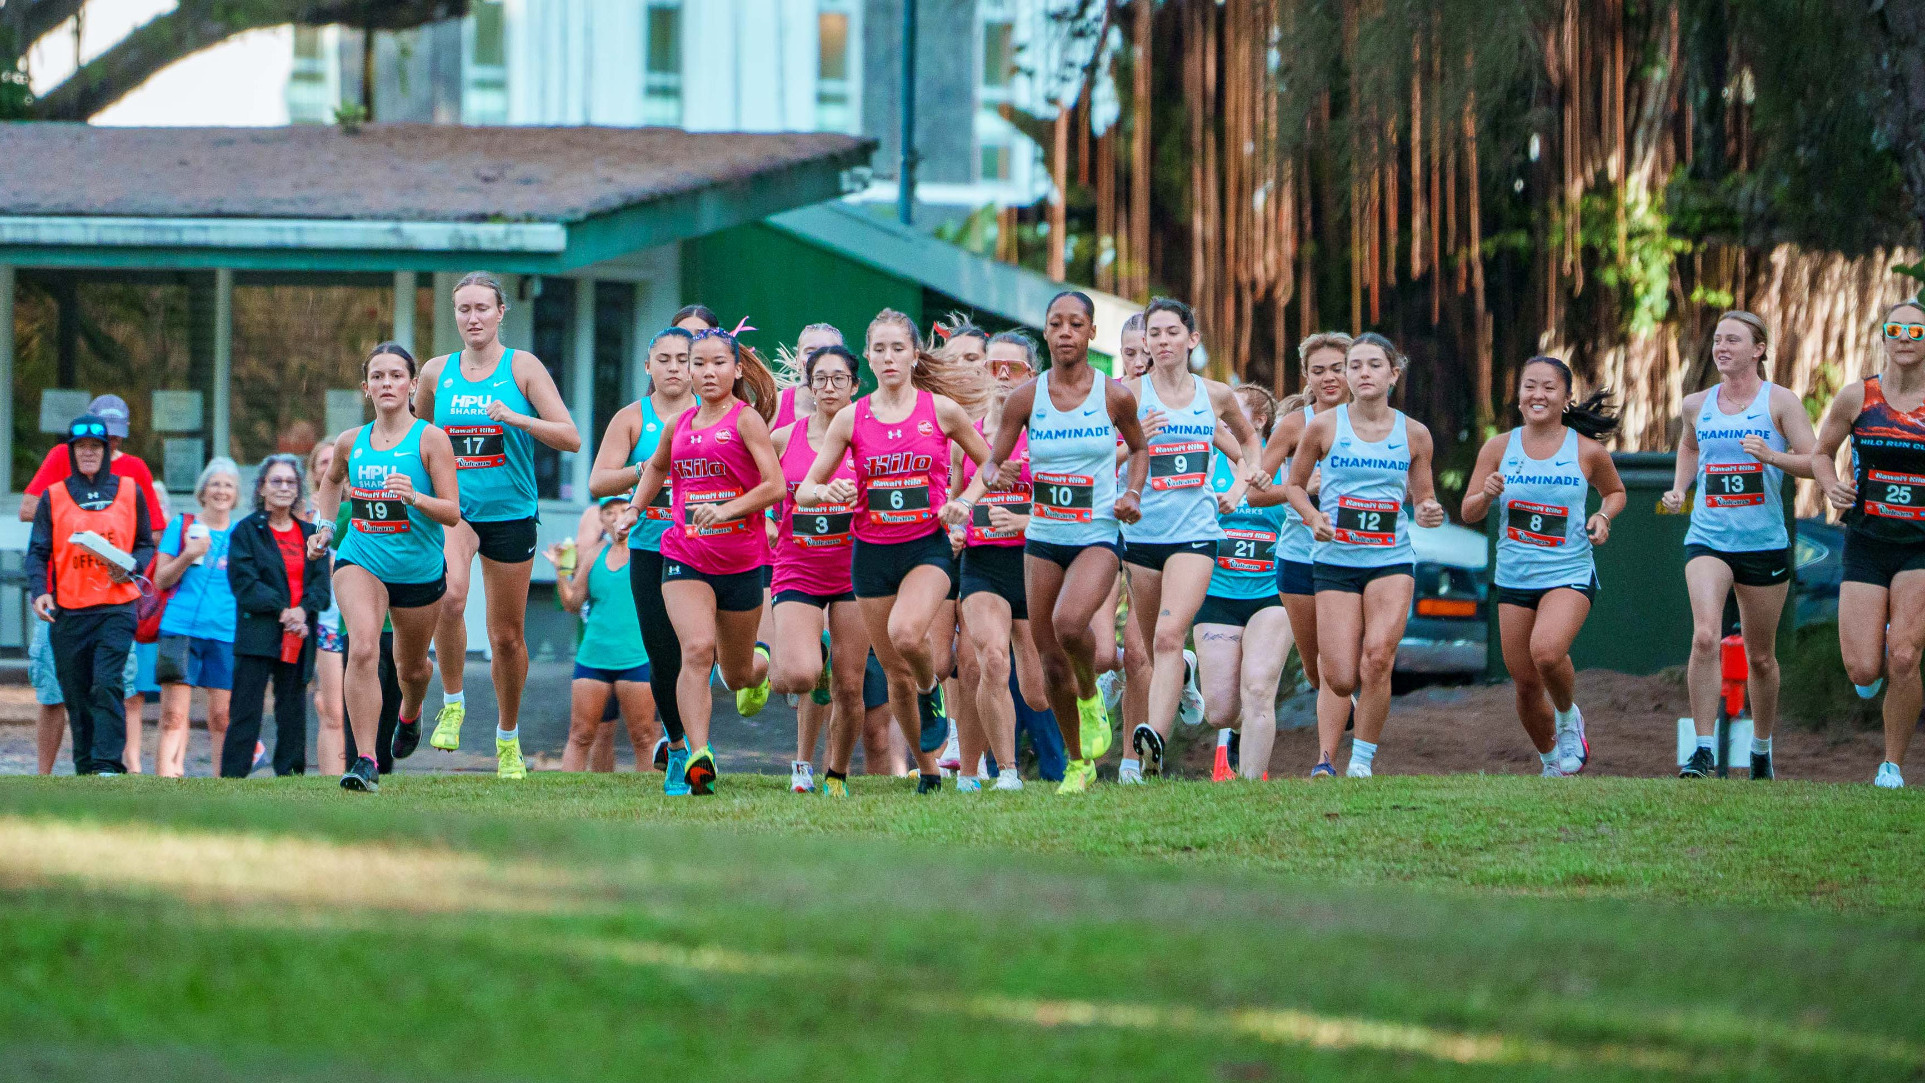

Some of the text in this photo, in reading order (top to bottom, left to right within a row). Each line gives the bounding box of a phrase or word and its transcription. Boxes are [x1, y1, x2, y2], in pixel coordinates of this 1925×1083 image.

[451, 394, 492, 409] HPU
[1030, 426, 1110, 441] CHAMINADE
[1158, 424, 1214, 436] AMINADE
[463, 437, 485, 455] 17
[1187, 443, 1205, 451] Hilo
[1860, 438, 1925, 451] HILO RUN CL
[674, 458, 726, 479] Hilo
[863, 451, 933, 476] Hilo
[1174, 455, 1188, 473] 9
[1330, 455, 1409, 471] CHAMINADE
[359, 480, 386, 488] SHAR
[904, 478, 922, 486] Hilo
[1068, 476, 1087, 484] Hilo
[1504, 474, 1580, 487] HAMINADE
[1721, 475, 1745, 493] 13
[665, 488, 673, 506] 1
[718, 491, 737, 499] Hilo
[890, 490, 904, 510] 6
[979, 495, 1005, 503] awai'i
[1049, 486, 1073, 506] 10
[1885, 484, 1912, 504] 25
[366, 502, 388, 519] 19
[829, 505, 846, 513] Hilo
[1378, 502, 1394, 510] Hilo
[1545, 506, 1563, 514] Hilo
[815, 516, 829, 534] 3
[1357, 511, 1381, 531] 12
[1530, 514, 1542, 532] 8
[1234, 541, 1256, 558] 21
